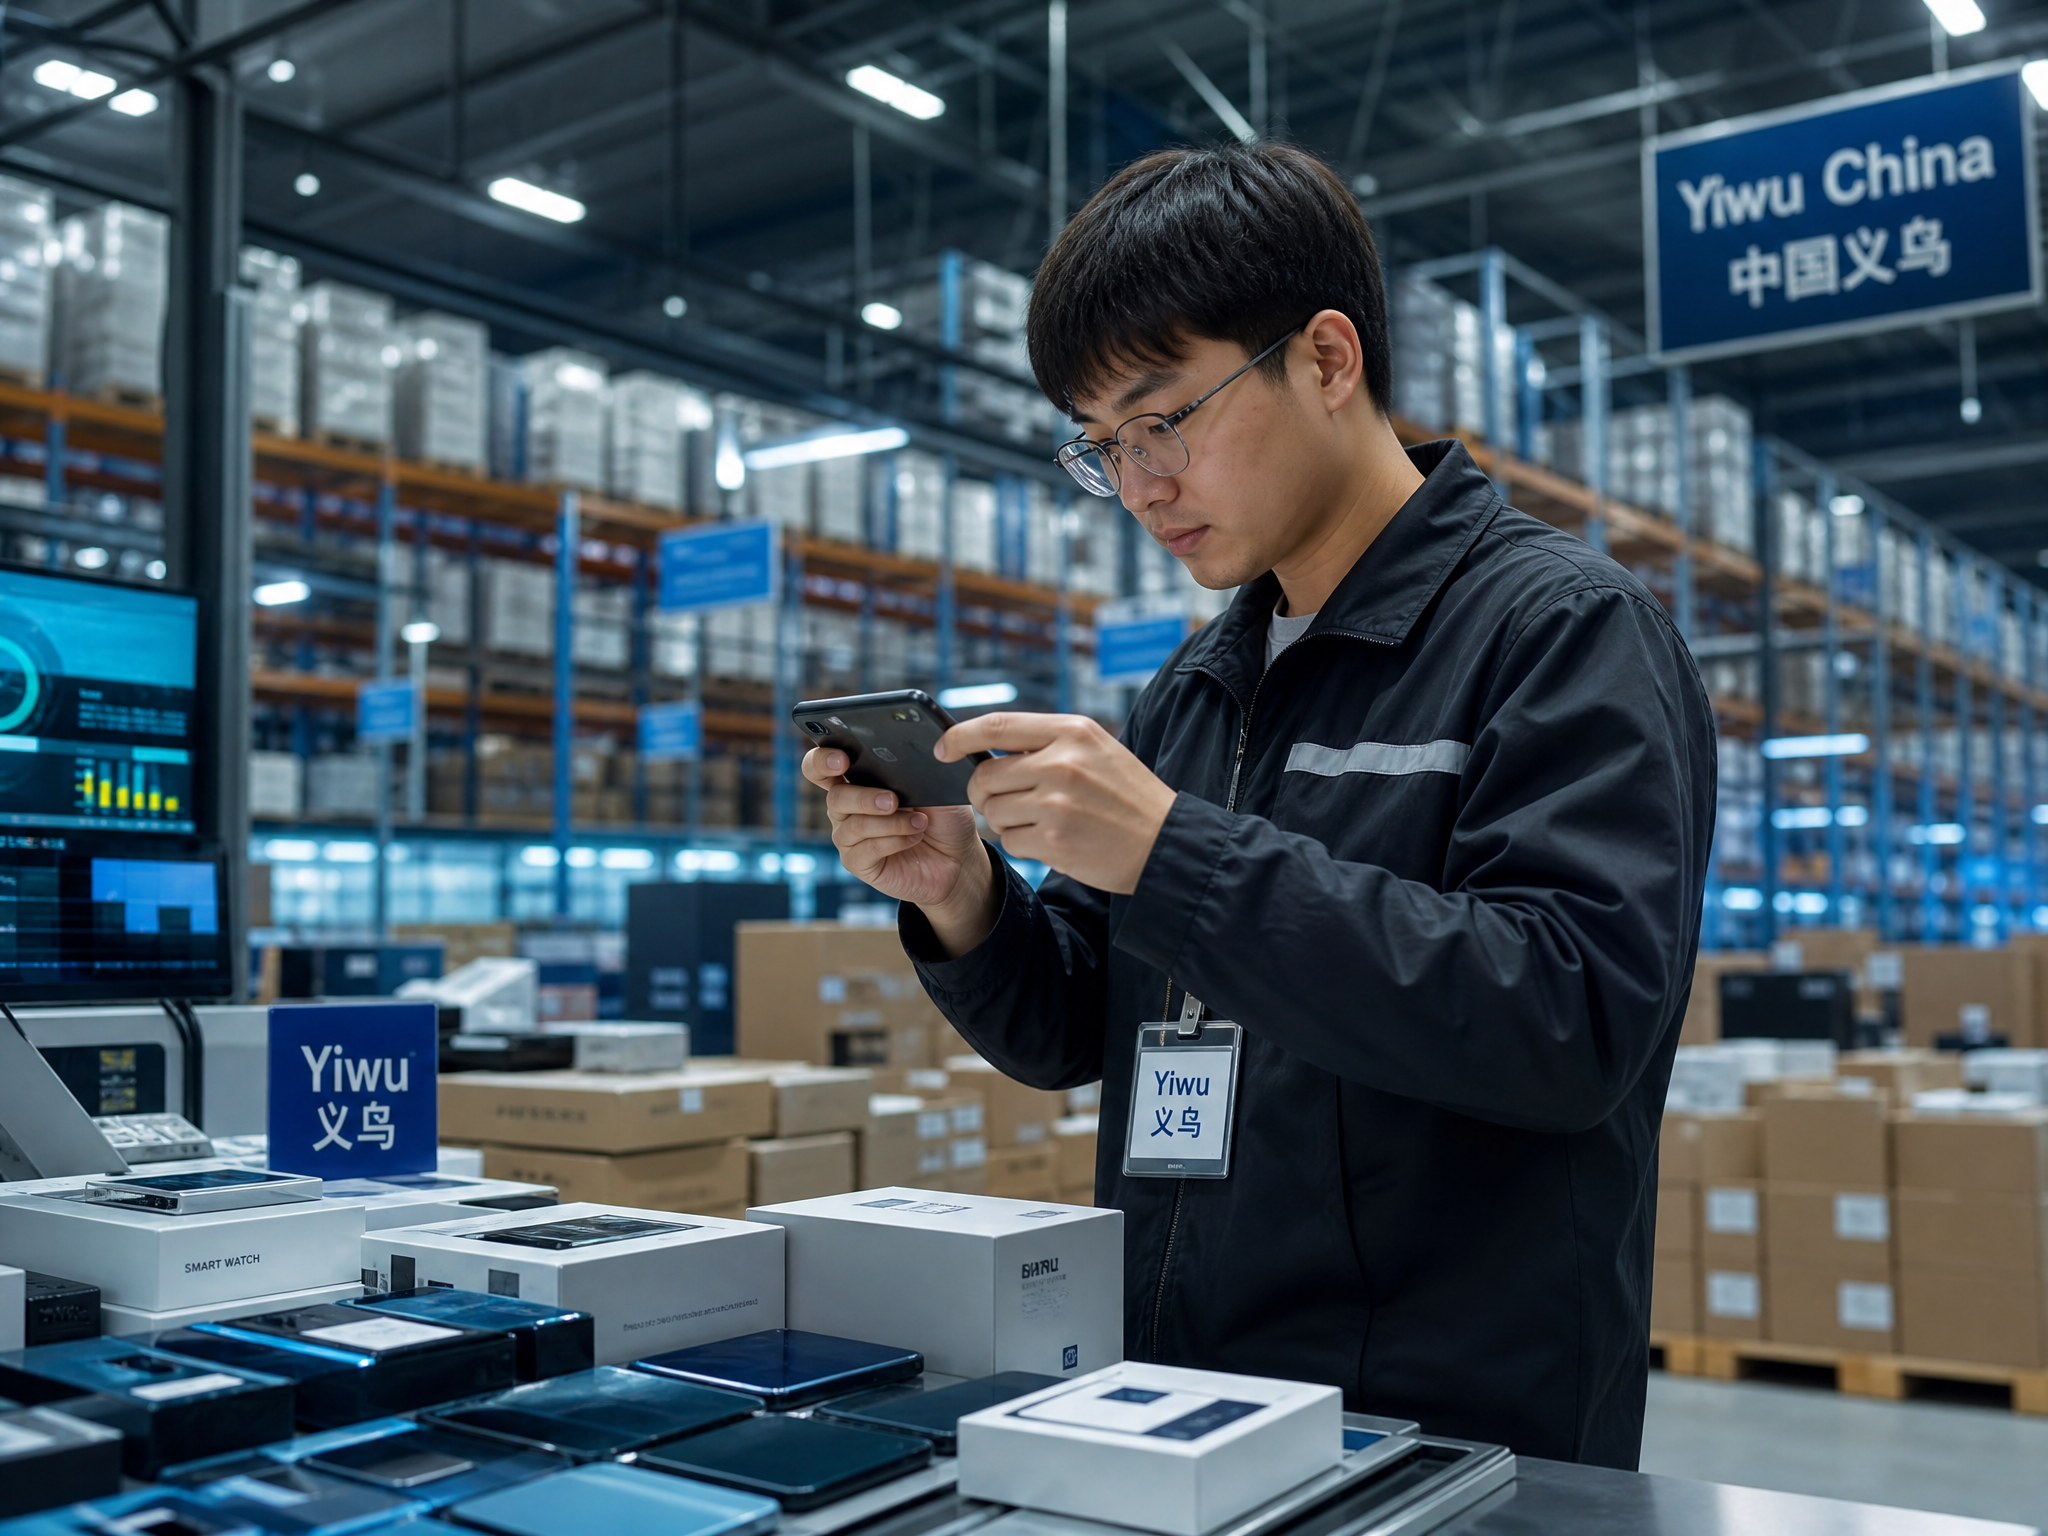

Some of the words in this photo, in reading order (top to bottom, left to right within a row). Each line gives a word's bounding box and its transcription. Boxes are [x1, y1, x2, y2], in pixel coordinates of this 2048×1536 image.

[1677, 173, 1805, 233] Yiwu
[1823, 135, 1996, 206] China
[1728, 215, 1952, 309] 中国义乌
[300, 1044, 409, 1093] Yiwu
[1154, 1070, 1210, 1097] Yiwu
[312, 1101, 396, 1152] 义乌
[1150, 1106, 1201, 1139] 义乌
[184, 1259, 222, 1274] SMART
[224, 1253, 260, 1268] WATCH
